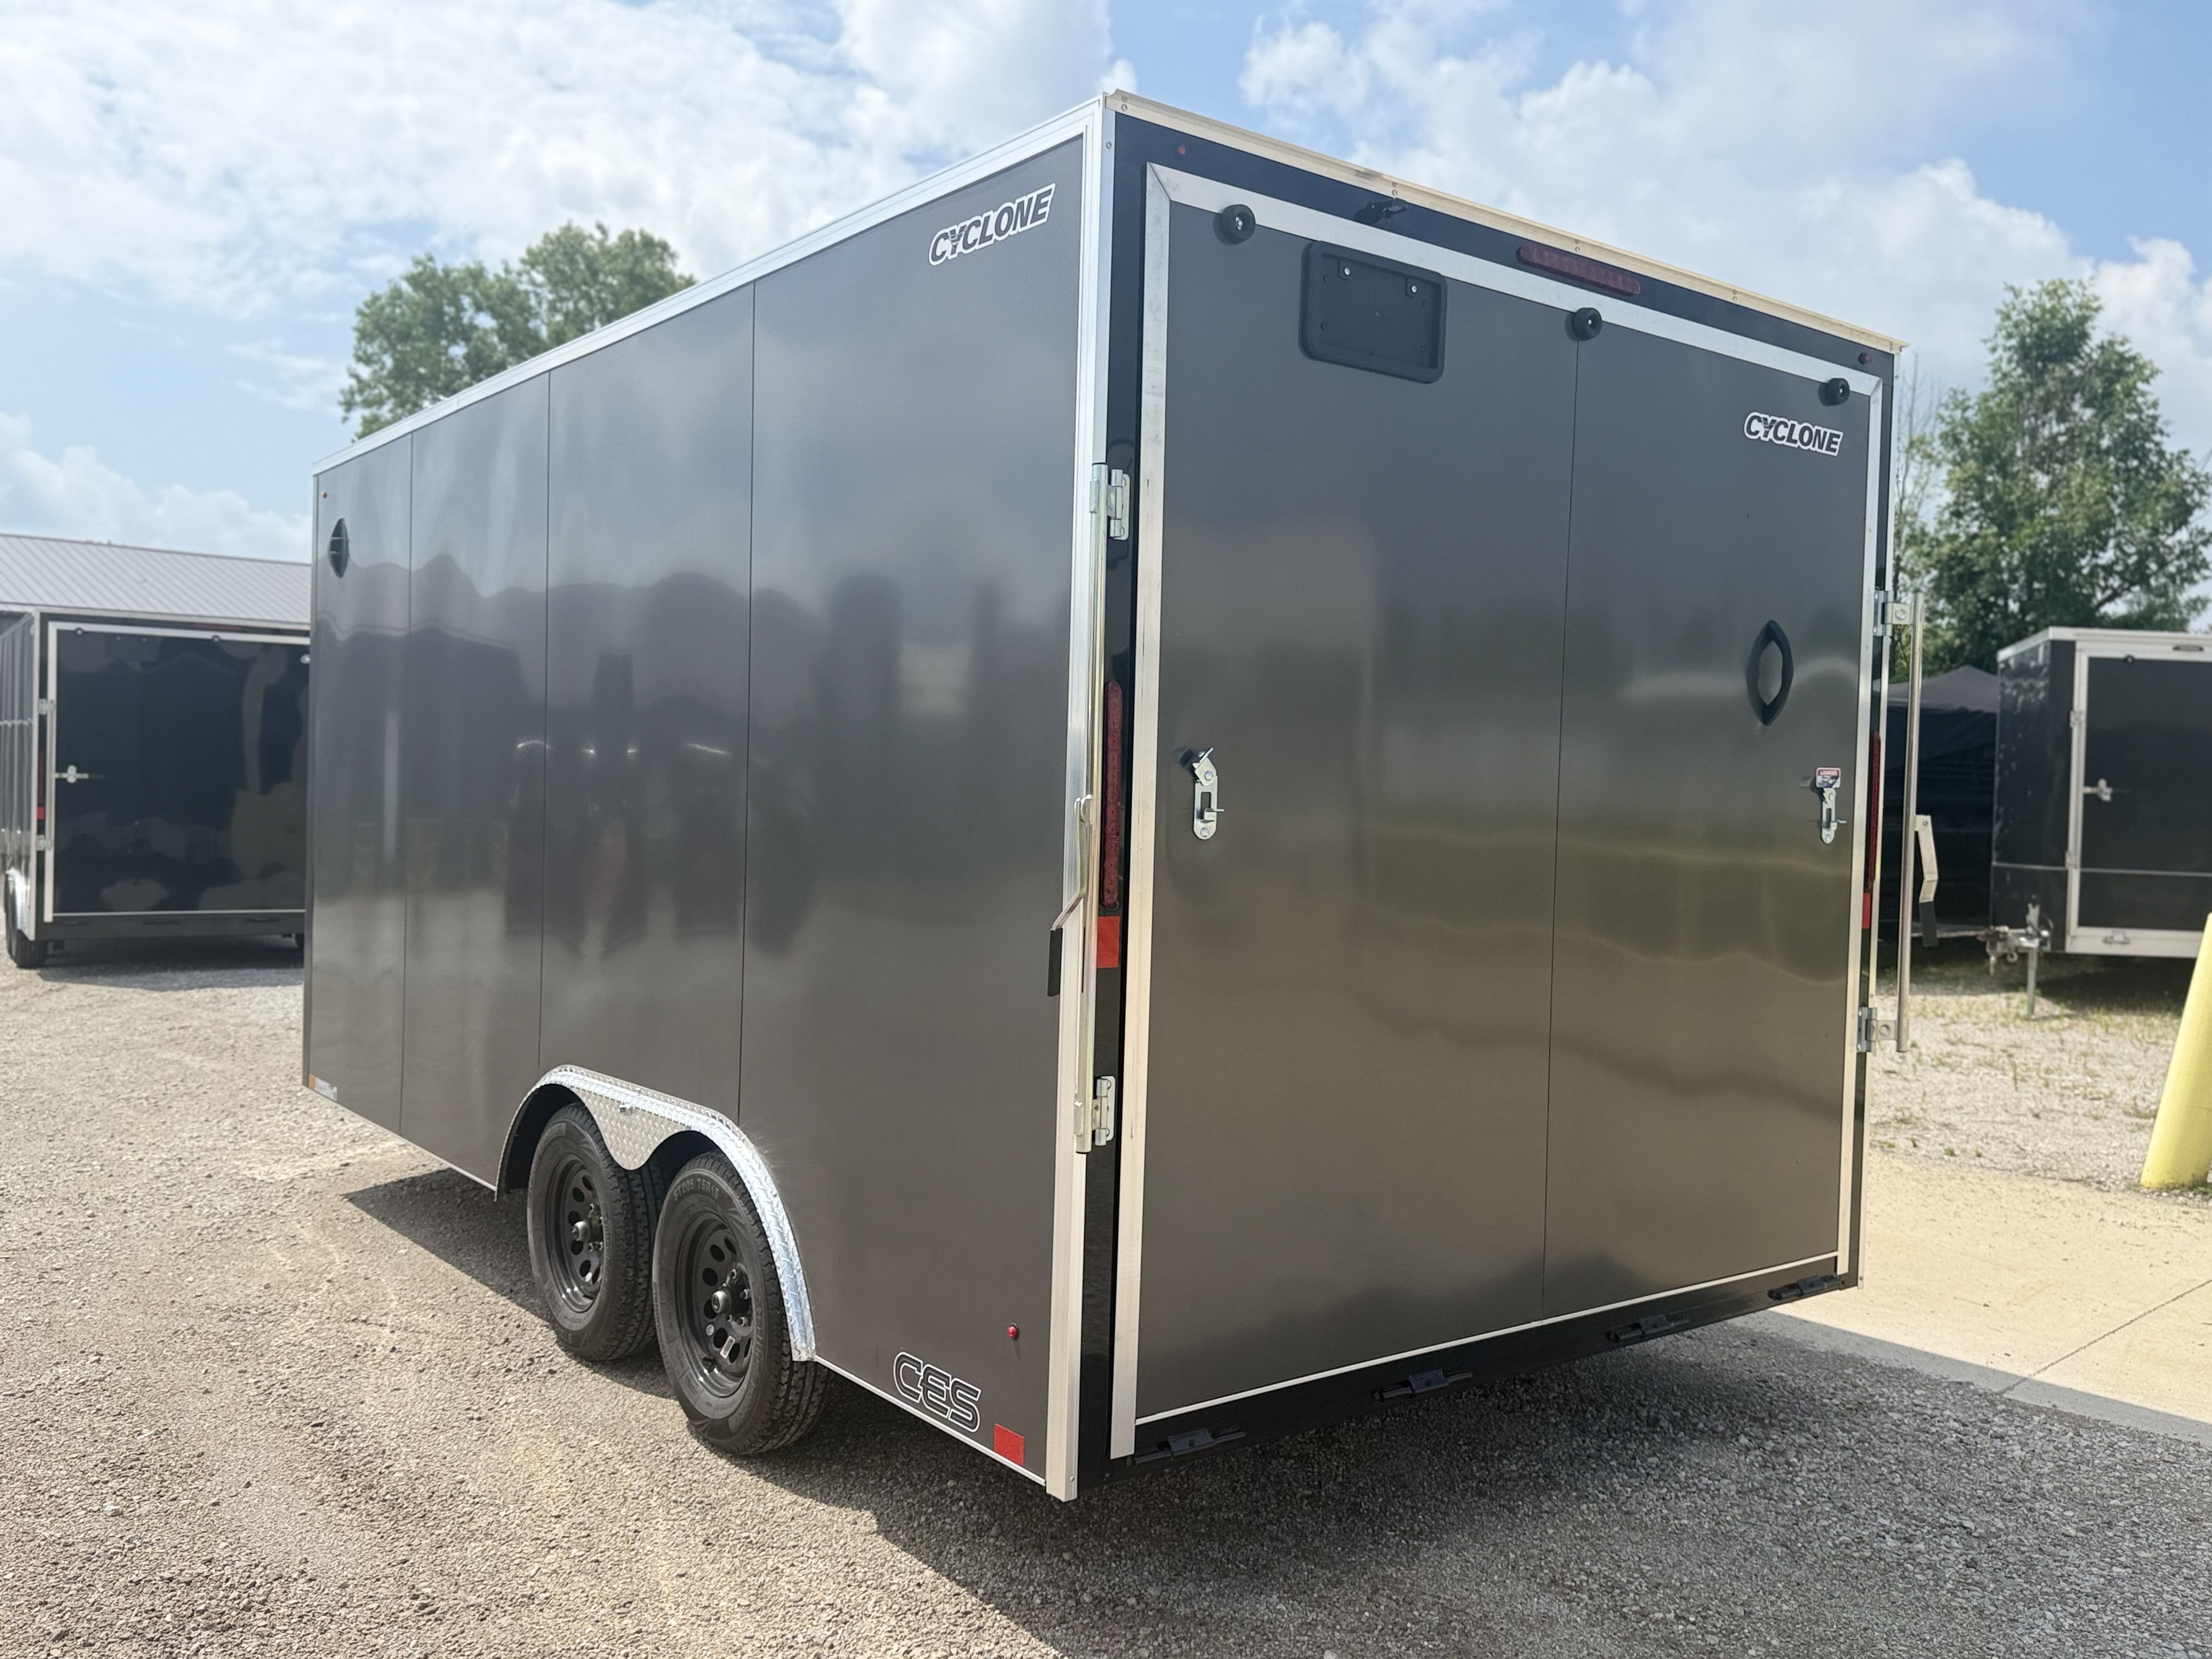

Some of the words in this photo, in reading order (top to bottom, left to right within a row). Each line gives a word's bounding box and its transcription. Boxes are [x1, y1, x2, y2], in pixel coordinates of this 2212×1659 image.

[929, 183, 1055, 265] CYCLONE
[1744, 412, 1843, 456] CYCLONE
[893, 1352, 981, 1432] CES
